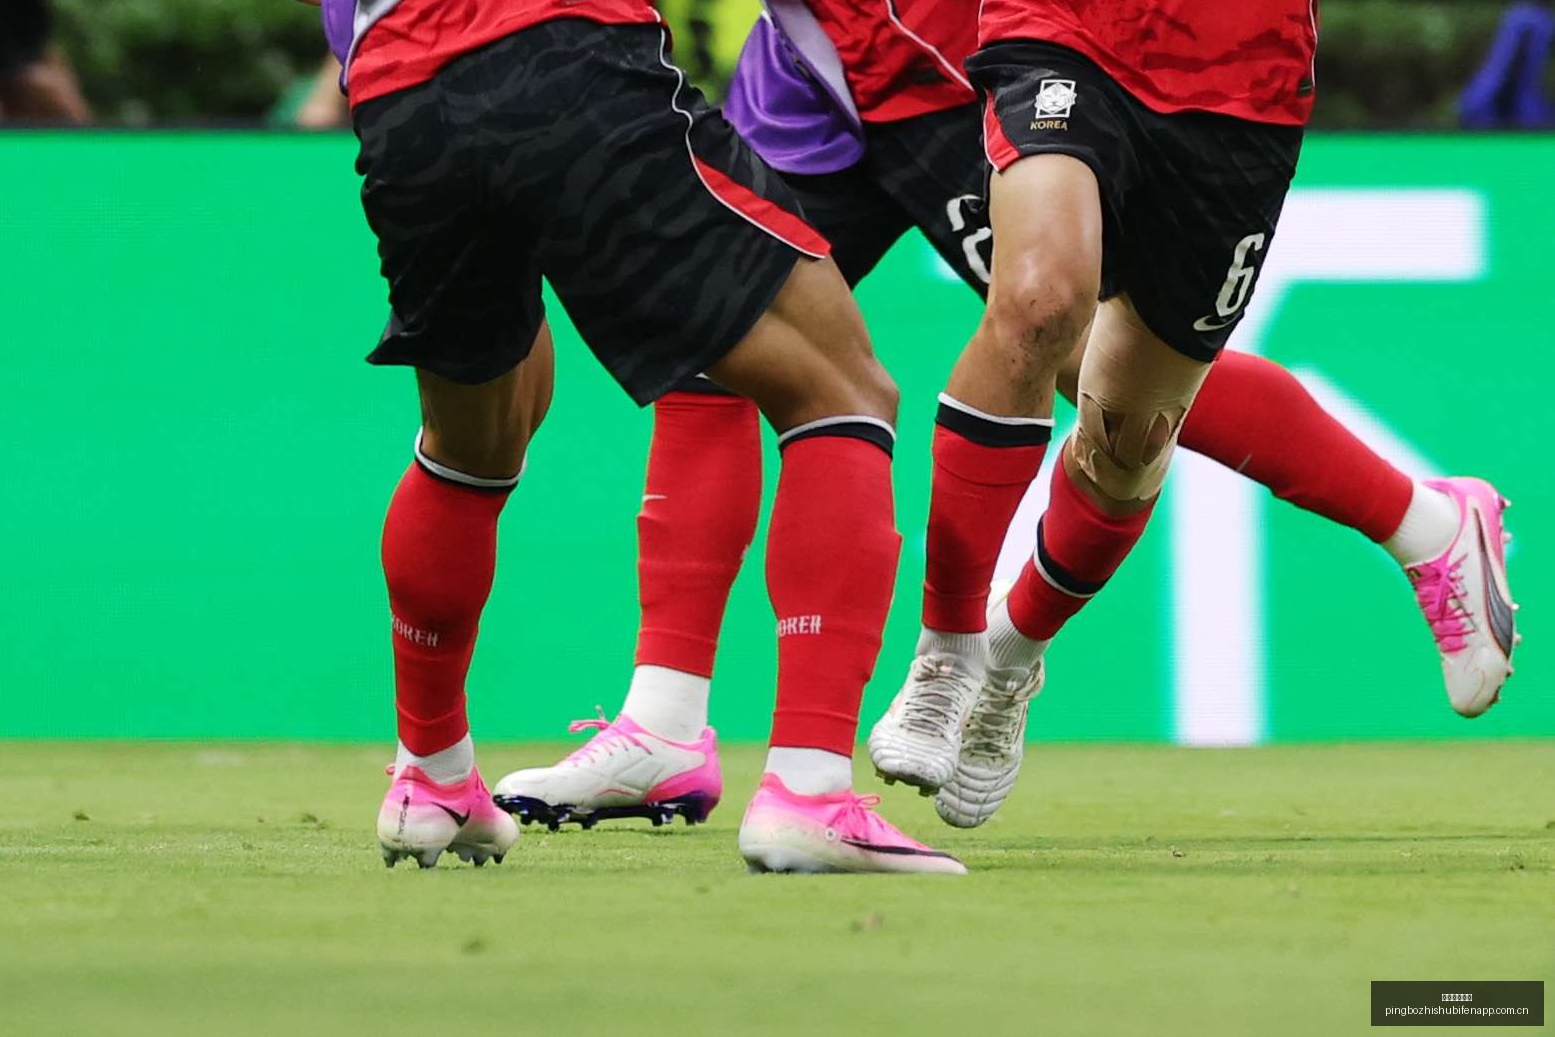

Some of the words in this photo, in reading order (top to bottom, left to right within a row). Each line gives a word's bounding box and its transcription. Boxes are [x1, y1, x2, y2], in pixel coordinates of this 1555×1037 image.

[1030, 120, 1068, 131] KOREA
[1215, 232, 1265, 317] 6
[778, 614, 822, 637] OREA
